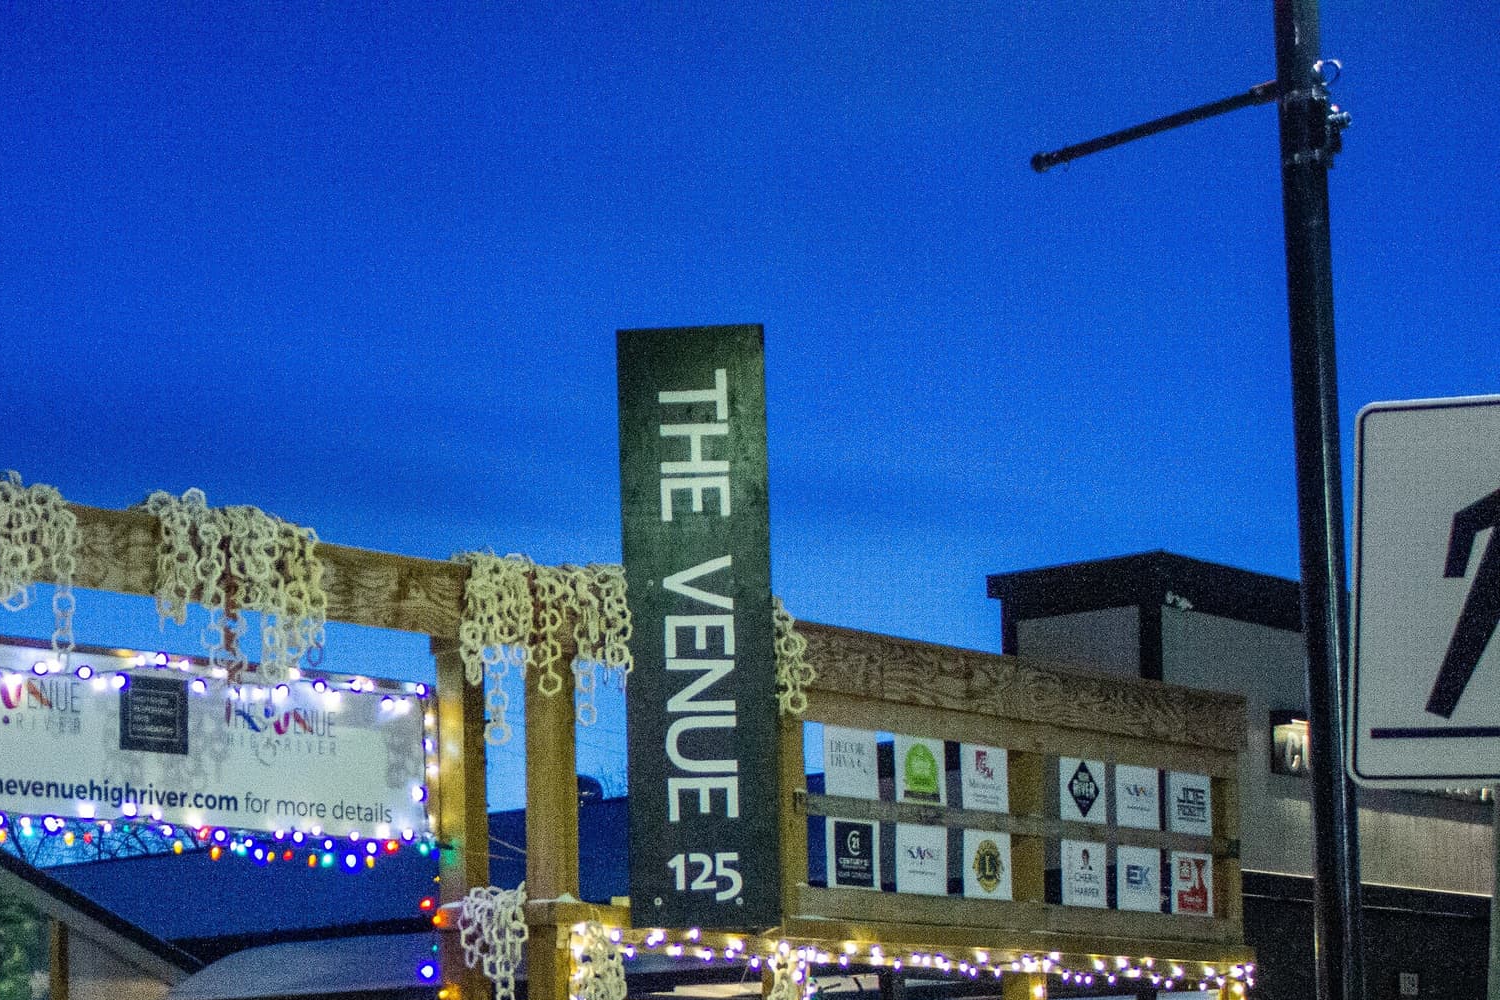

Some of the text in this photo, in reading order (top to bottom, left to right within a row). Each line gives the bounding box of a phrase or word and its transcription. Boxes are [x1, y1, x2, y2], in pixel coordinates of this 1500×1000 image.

[657, 368, 740, 822] THE VENUE
[245, 792, 271, 814] for
[276, 800, 327, 819] more
[332, 800, 393, 823] details
[667, 852, 744, 901] 125
